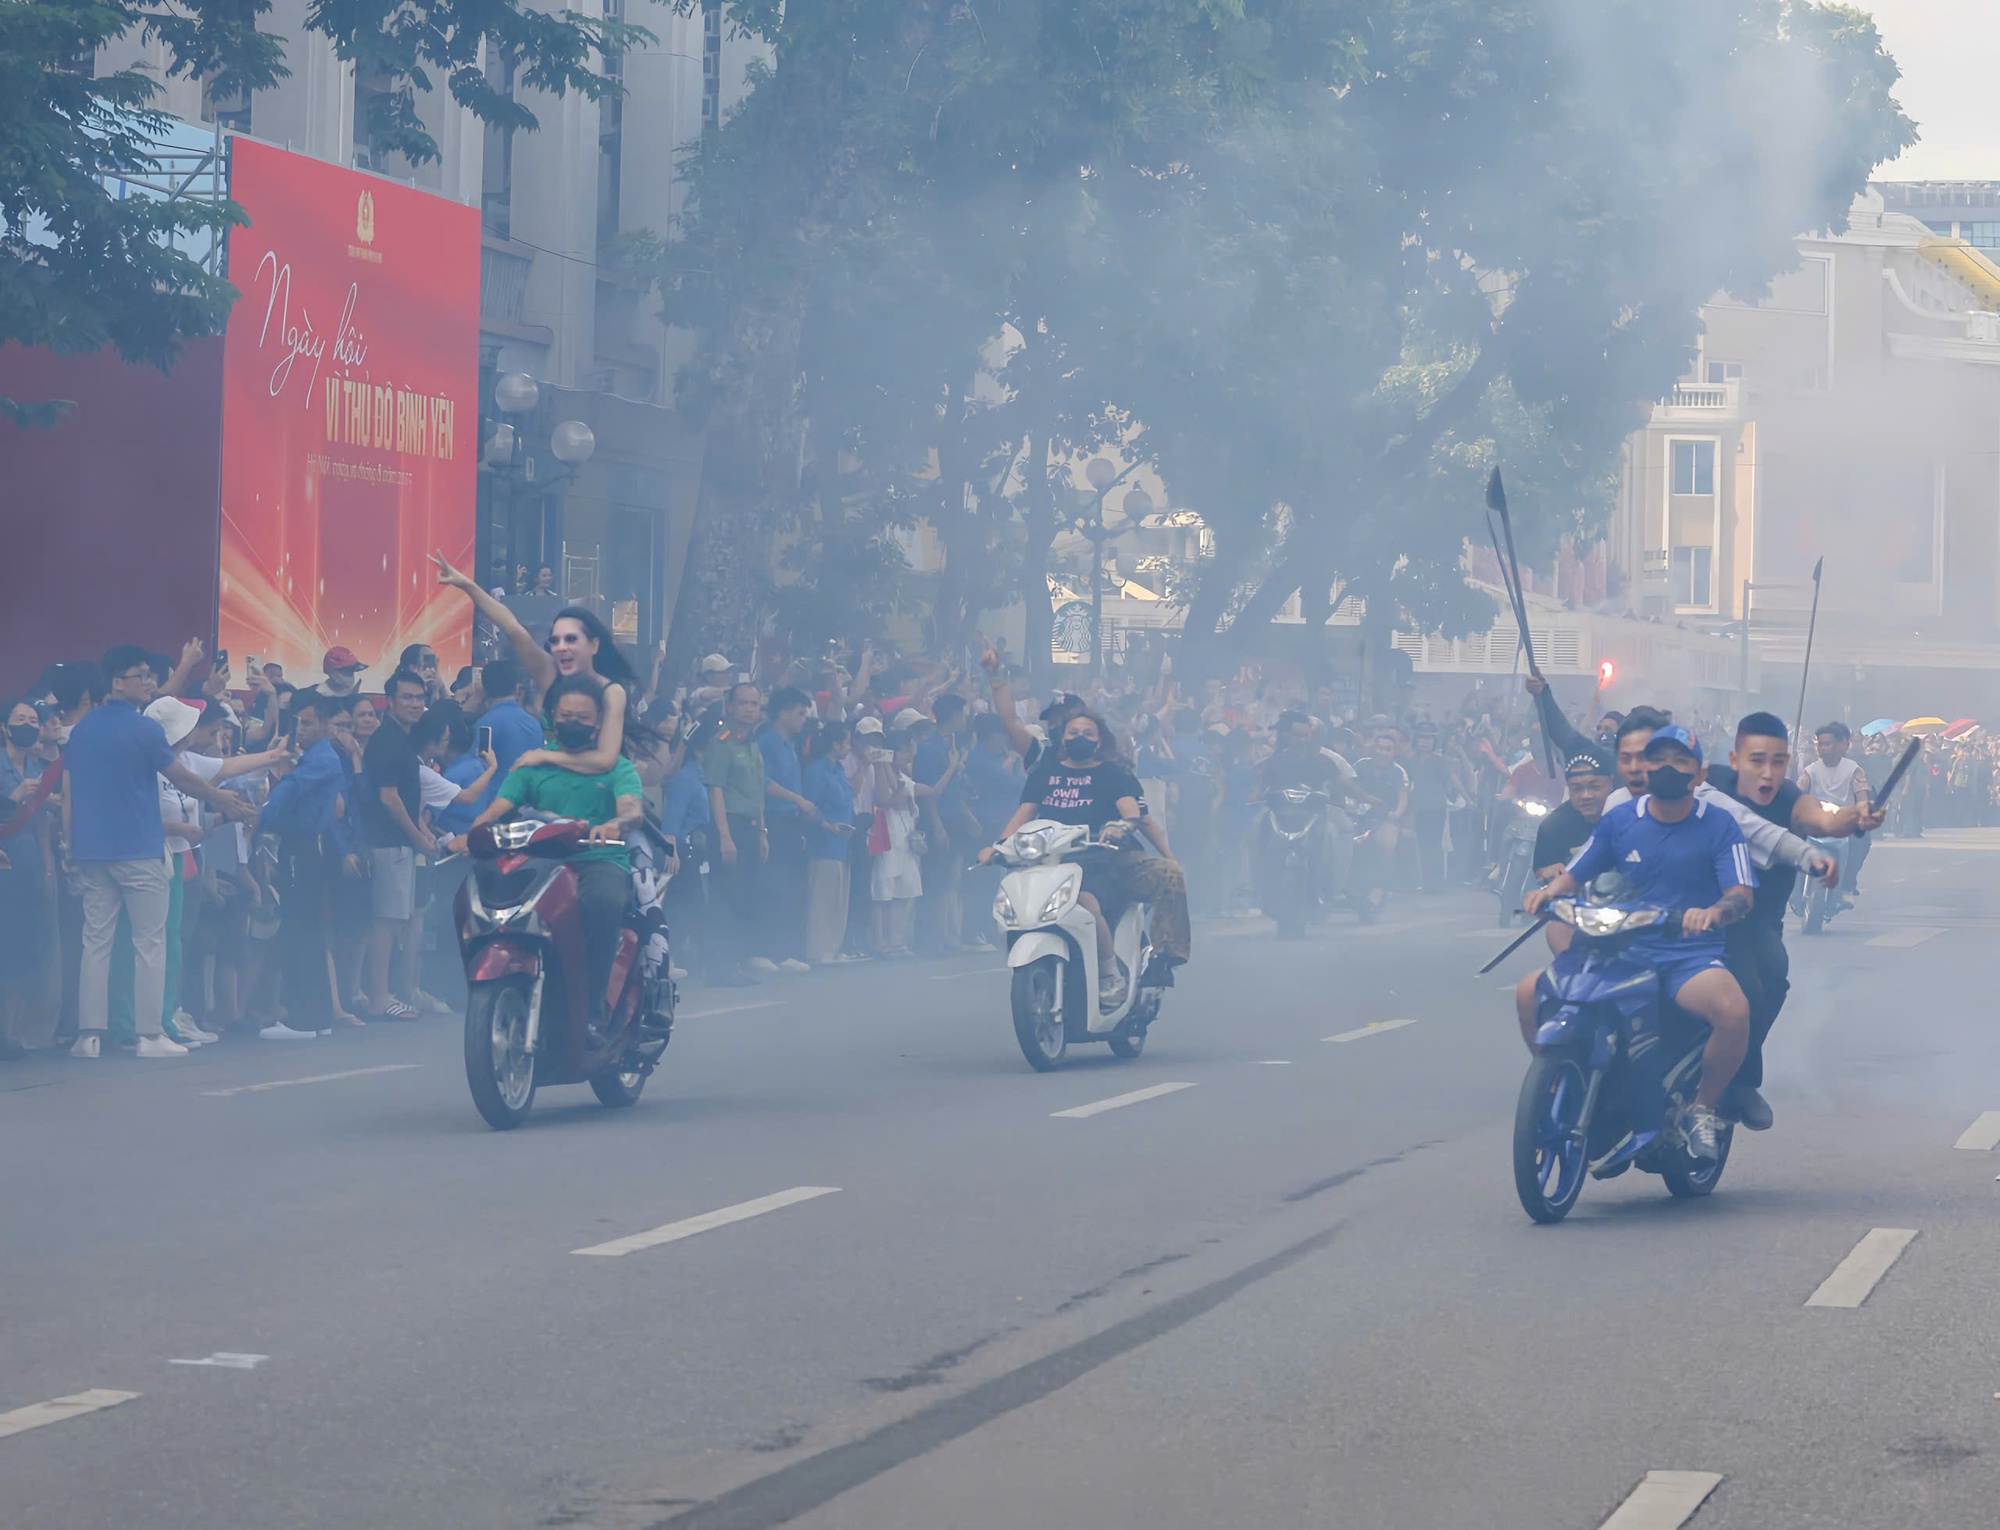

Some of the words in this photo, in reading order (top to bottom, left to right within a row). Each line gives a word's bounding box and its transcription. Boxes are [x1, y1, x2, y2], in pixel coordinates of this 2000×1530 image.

[254, 250, 326, 410] Ngày
[333, 282, 368, 376] hội
[325, 370, 341, 442] VÌ
[343, 369, 372, 448] THỦ
[374, 381, 394, 451] ĐÔ
[396, 384, 428, 456] BÌNH
[430, 391, 455, 461] YÊN
[1053, 788, 1079, 799] OWN
[1066, 775, 1092, 786] YOUR
